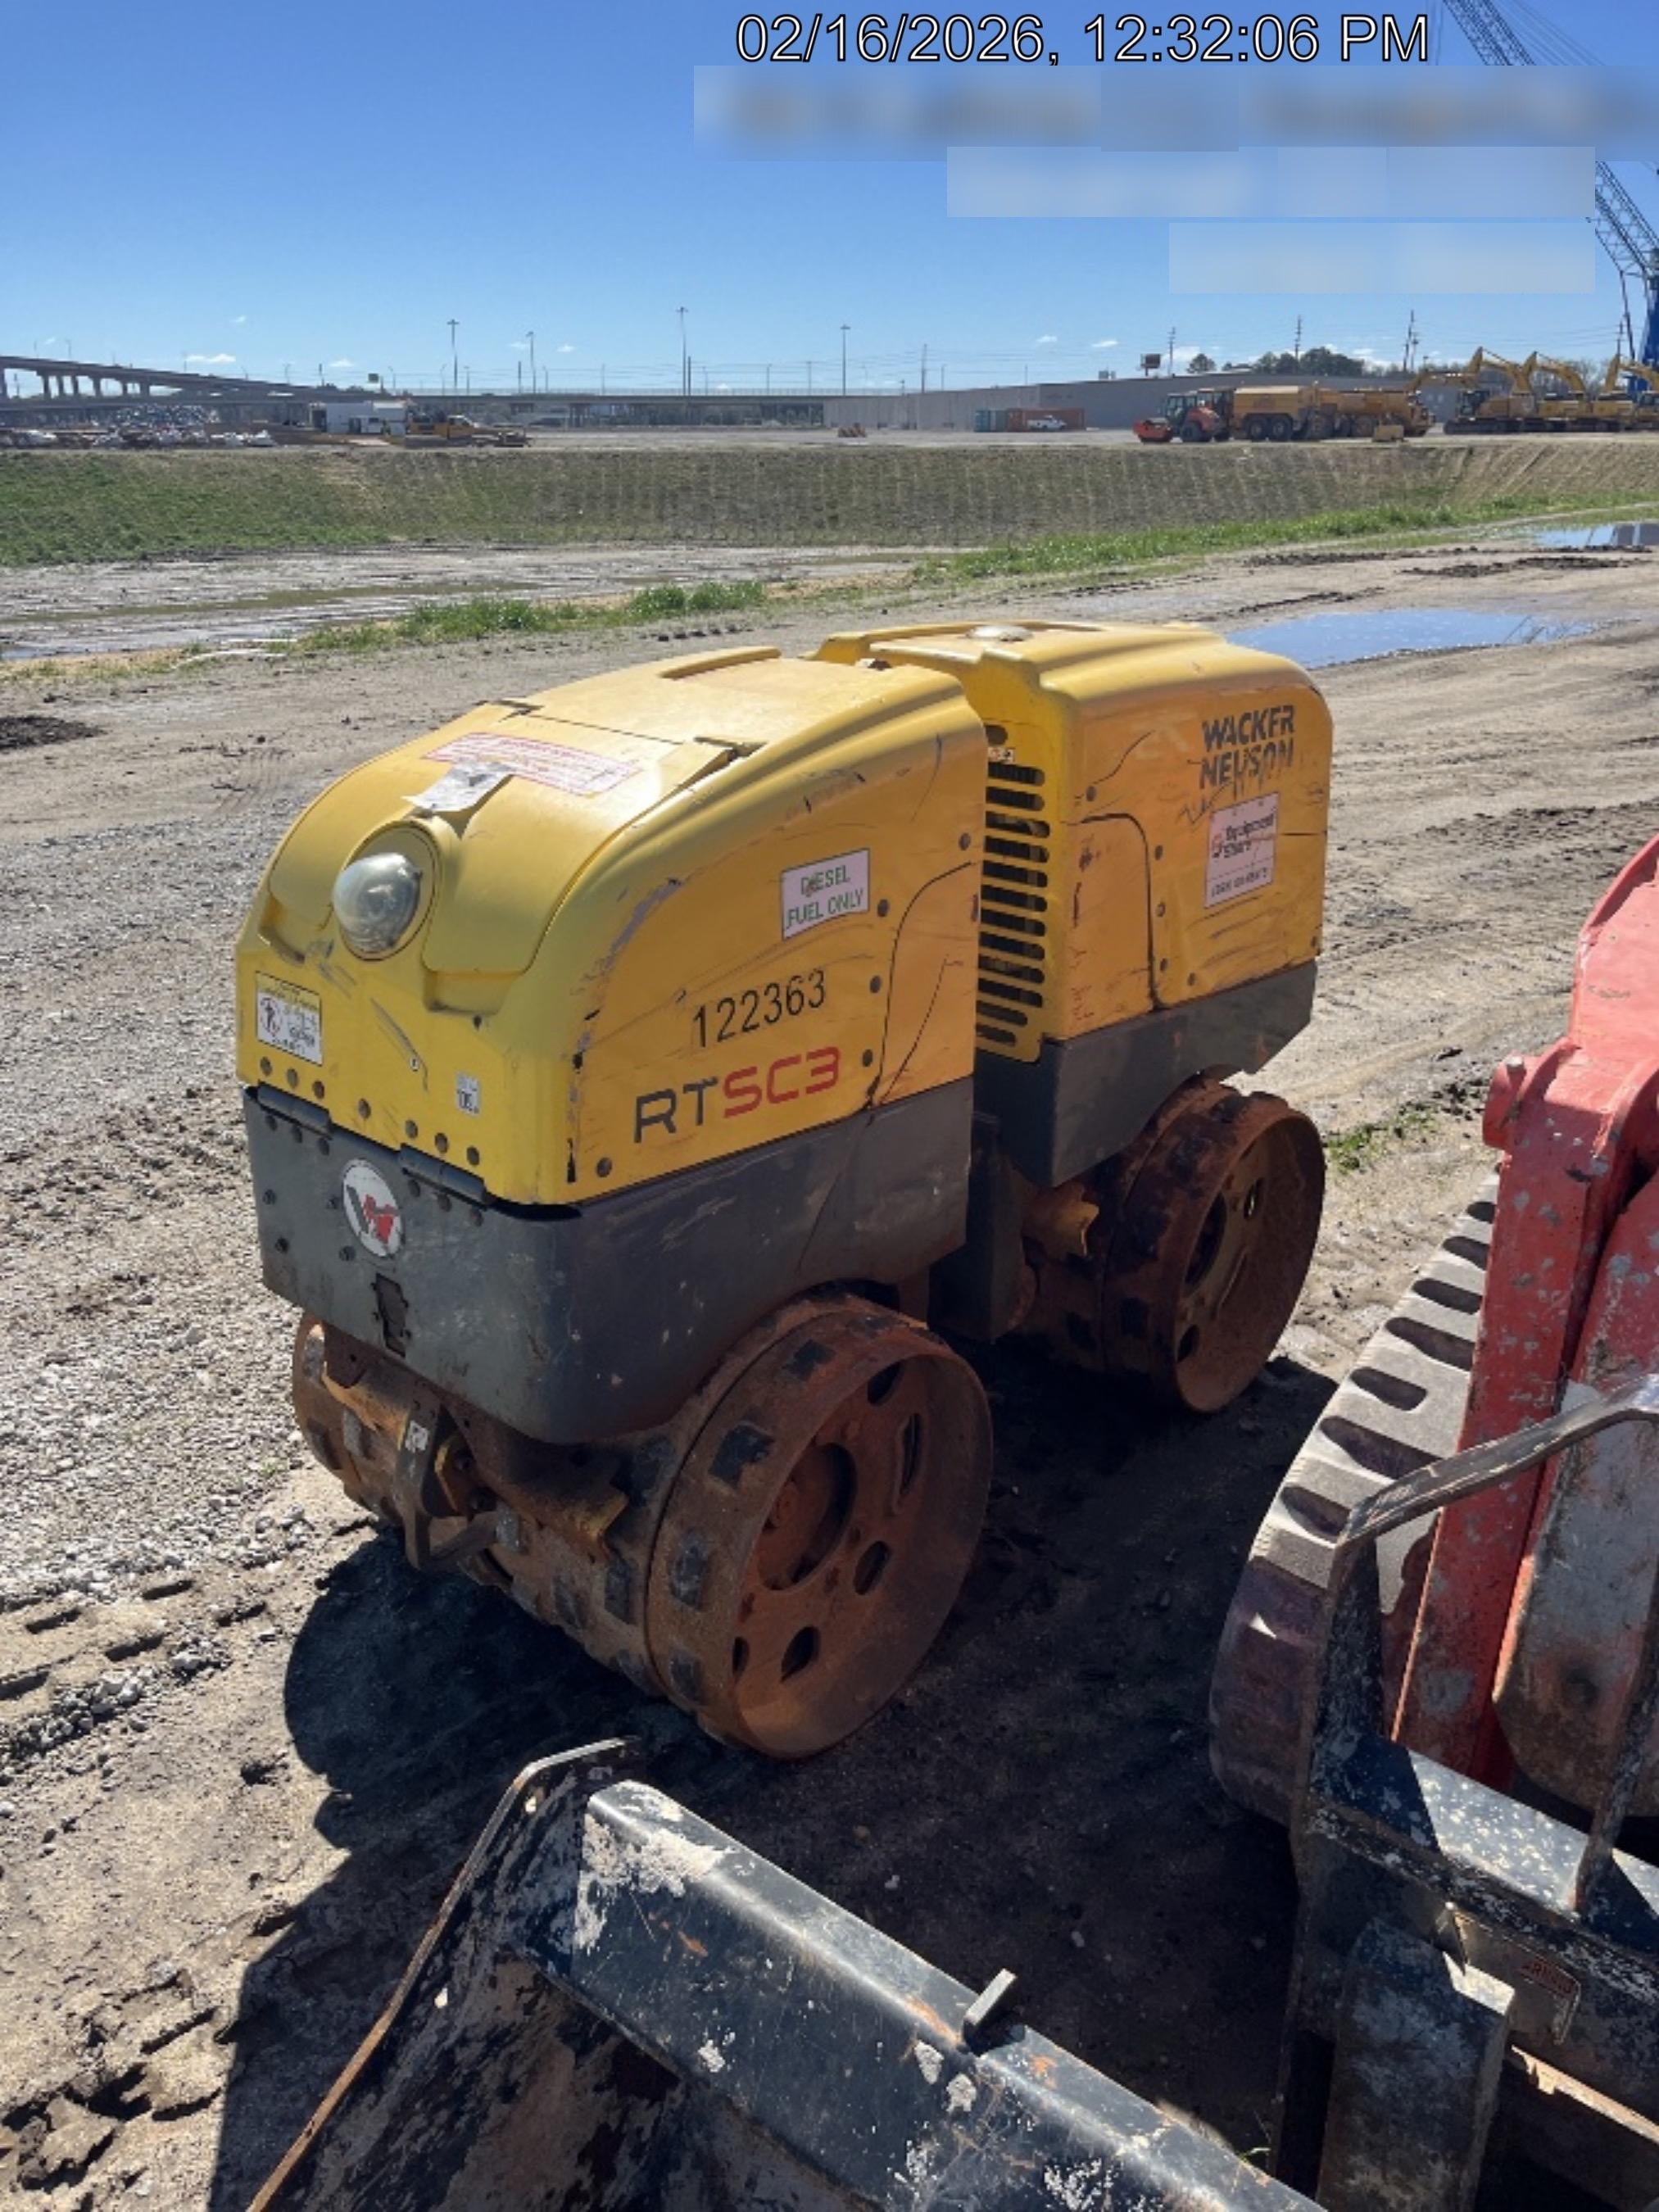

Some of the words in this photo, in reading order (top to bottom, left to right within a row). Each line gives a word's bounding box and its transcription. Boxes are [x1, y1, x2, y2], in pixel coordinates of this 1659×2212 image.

[786, 901, 824, 930] FUEL
[827, 887, 864, 914] ONLY
[692, 968, 827, 1048] 122363
[633, 1045, 841, 1144] RTSC3
